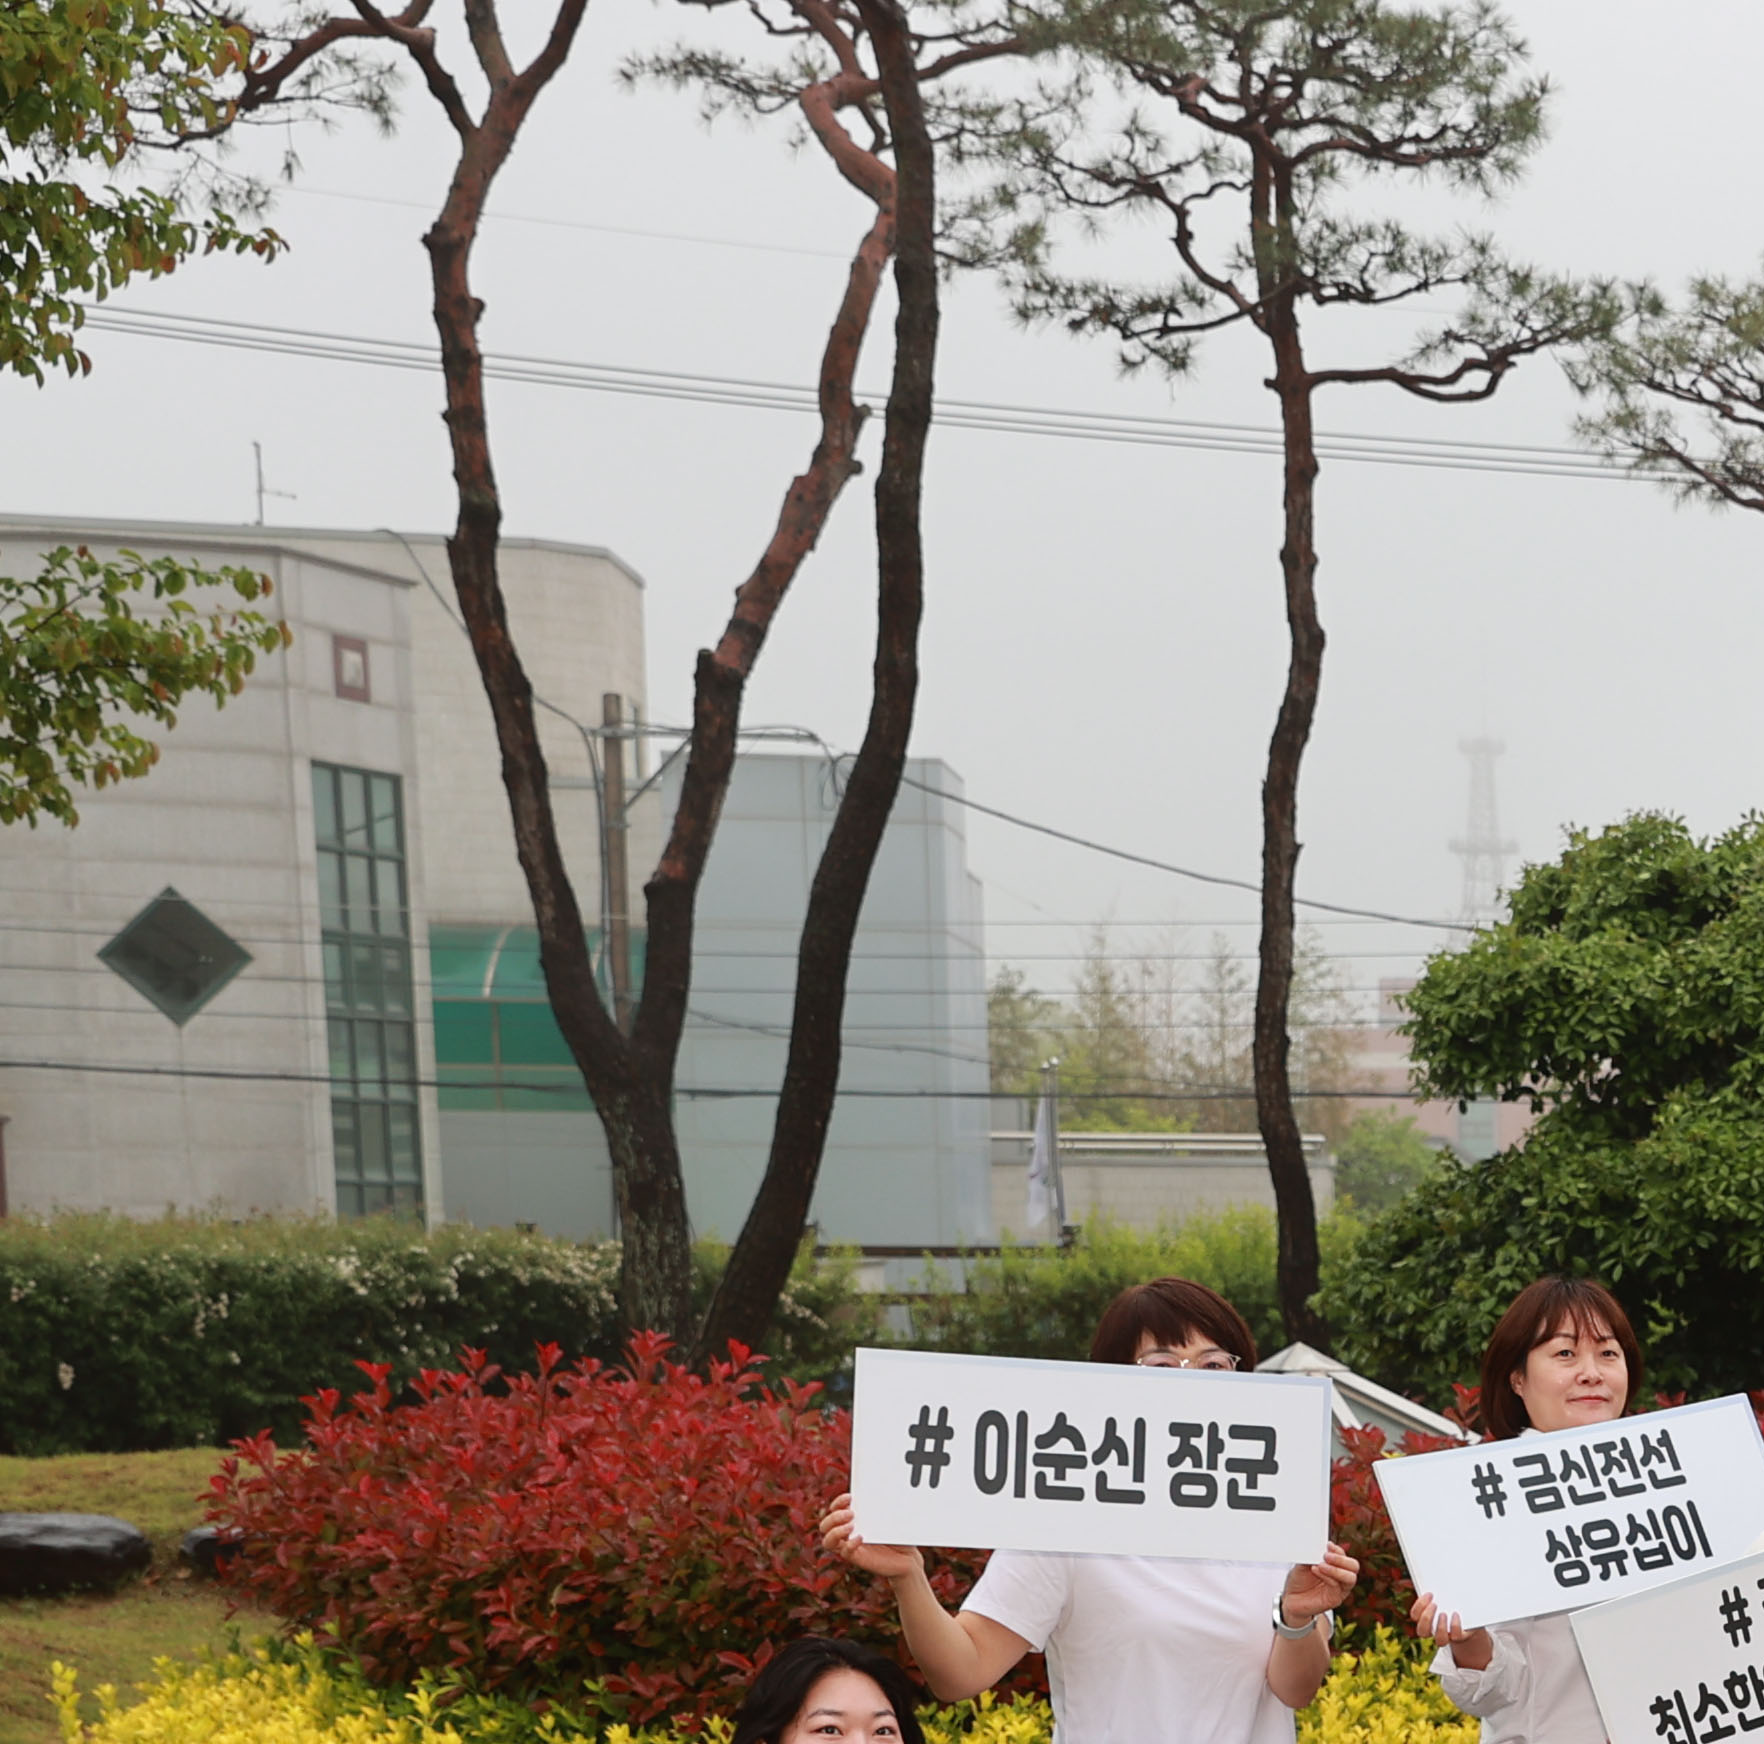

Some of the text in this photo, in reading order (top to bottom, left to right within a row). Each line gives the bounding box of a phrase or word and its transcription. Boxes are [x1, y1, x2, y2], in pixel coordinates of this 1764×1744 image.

[904, 1404, 1279, 1512] # 이순신 장군
[1471, 1429, 1687, 1519] # 금신전선
[1545, 1500, 1713, 1588] 상유십이
[1719, 1585, 1753, 1648] #
